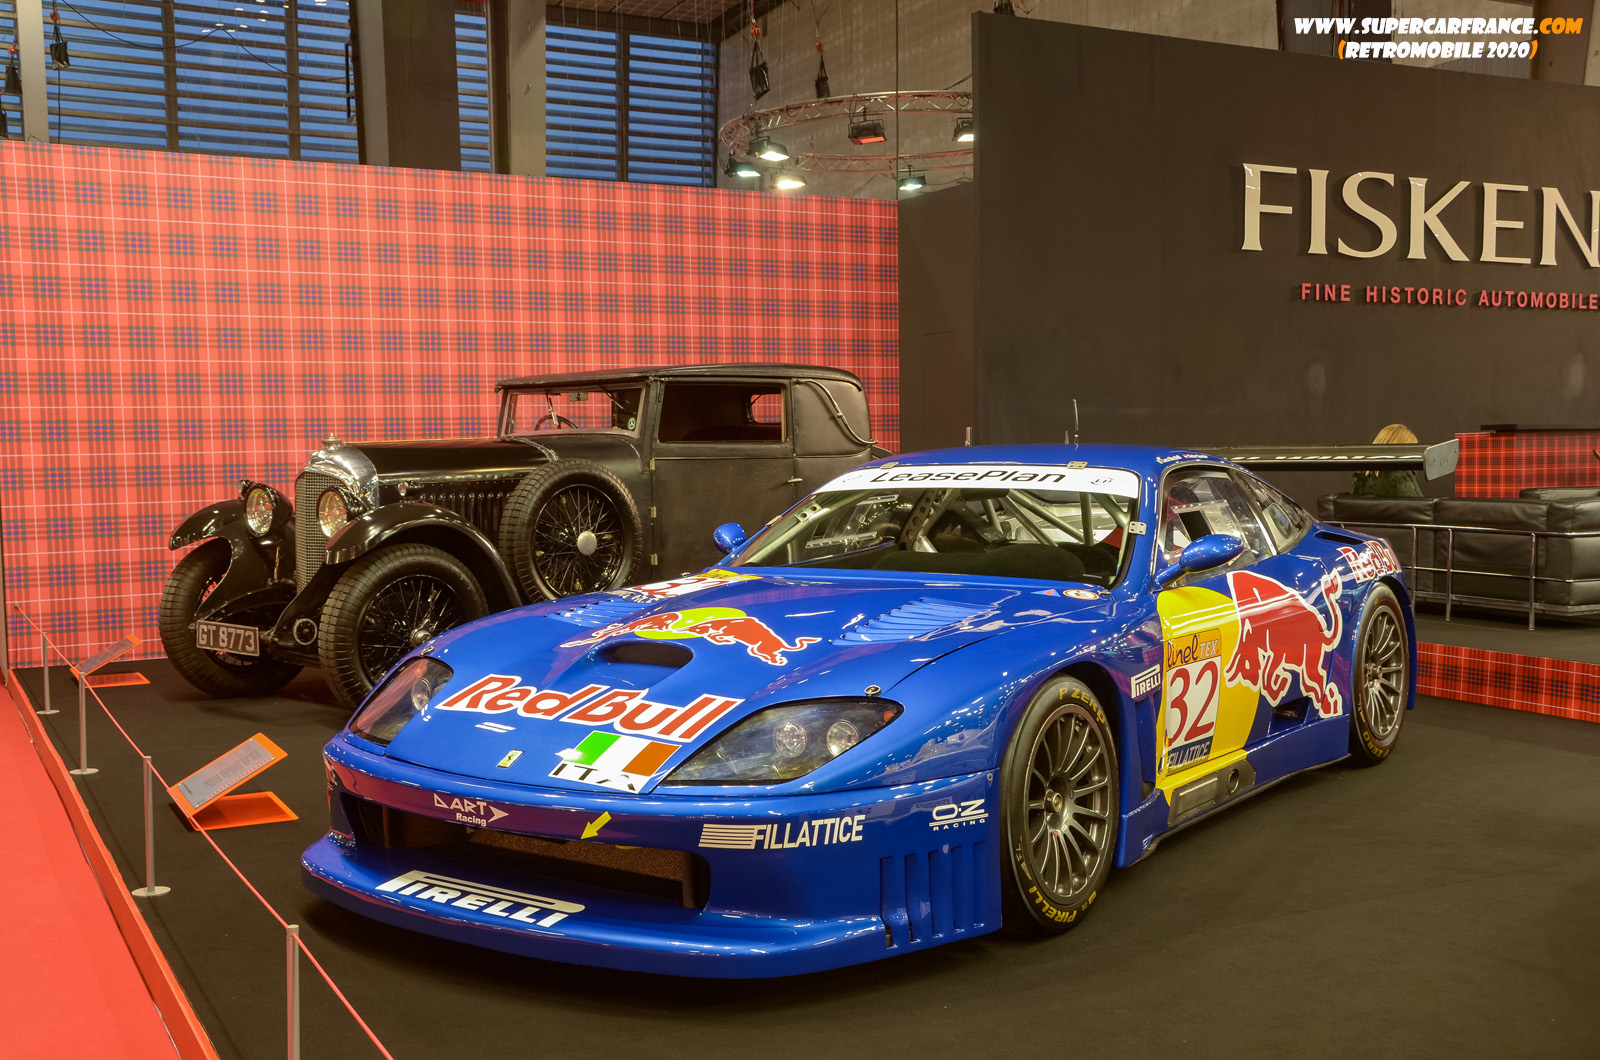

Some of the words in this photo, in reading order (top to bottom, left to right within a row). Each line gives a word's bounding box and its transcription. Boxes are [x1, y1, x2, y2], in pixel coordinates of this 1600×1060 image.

[1241, 163, 1600, 268] FISKEN
[1301, 283, 1351, 302] FINE
[1366, 286, 1468, 306] HISTORIC
[1478, 290, 1599, 310] AUTOMOBILE
[869, 470, 1067, 483] LeasePlan
[200, 625, 216, 646] GT
[219, 627, 255, 652] 8773
[1131, 664, 1161, 699] PIRELLI
[1059, 687, 1068, 700] P
[1071, 687, 1106, 724] ZERO
[1165, 661, 1219, 747] 32
[456, 812, 487, 827] Racing
[750, 814, 866, 849] FILLATTICE
[933, 818, 986, 832] RACING
[375, 869, 586, 928] PIRELLI
[1028, 885, 1077, 923] PIRELLI
